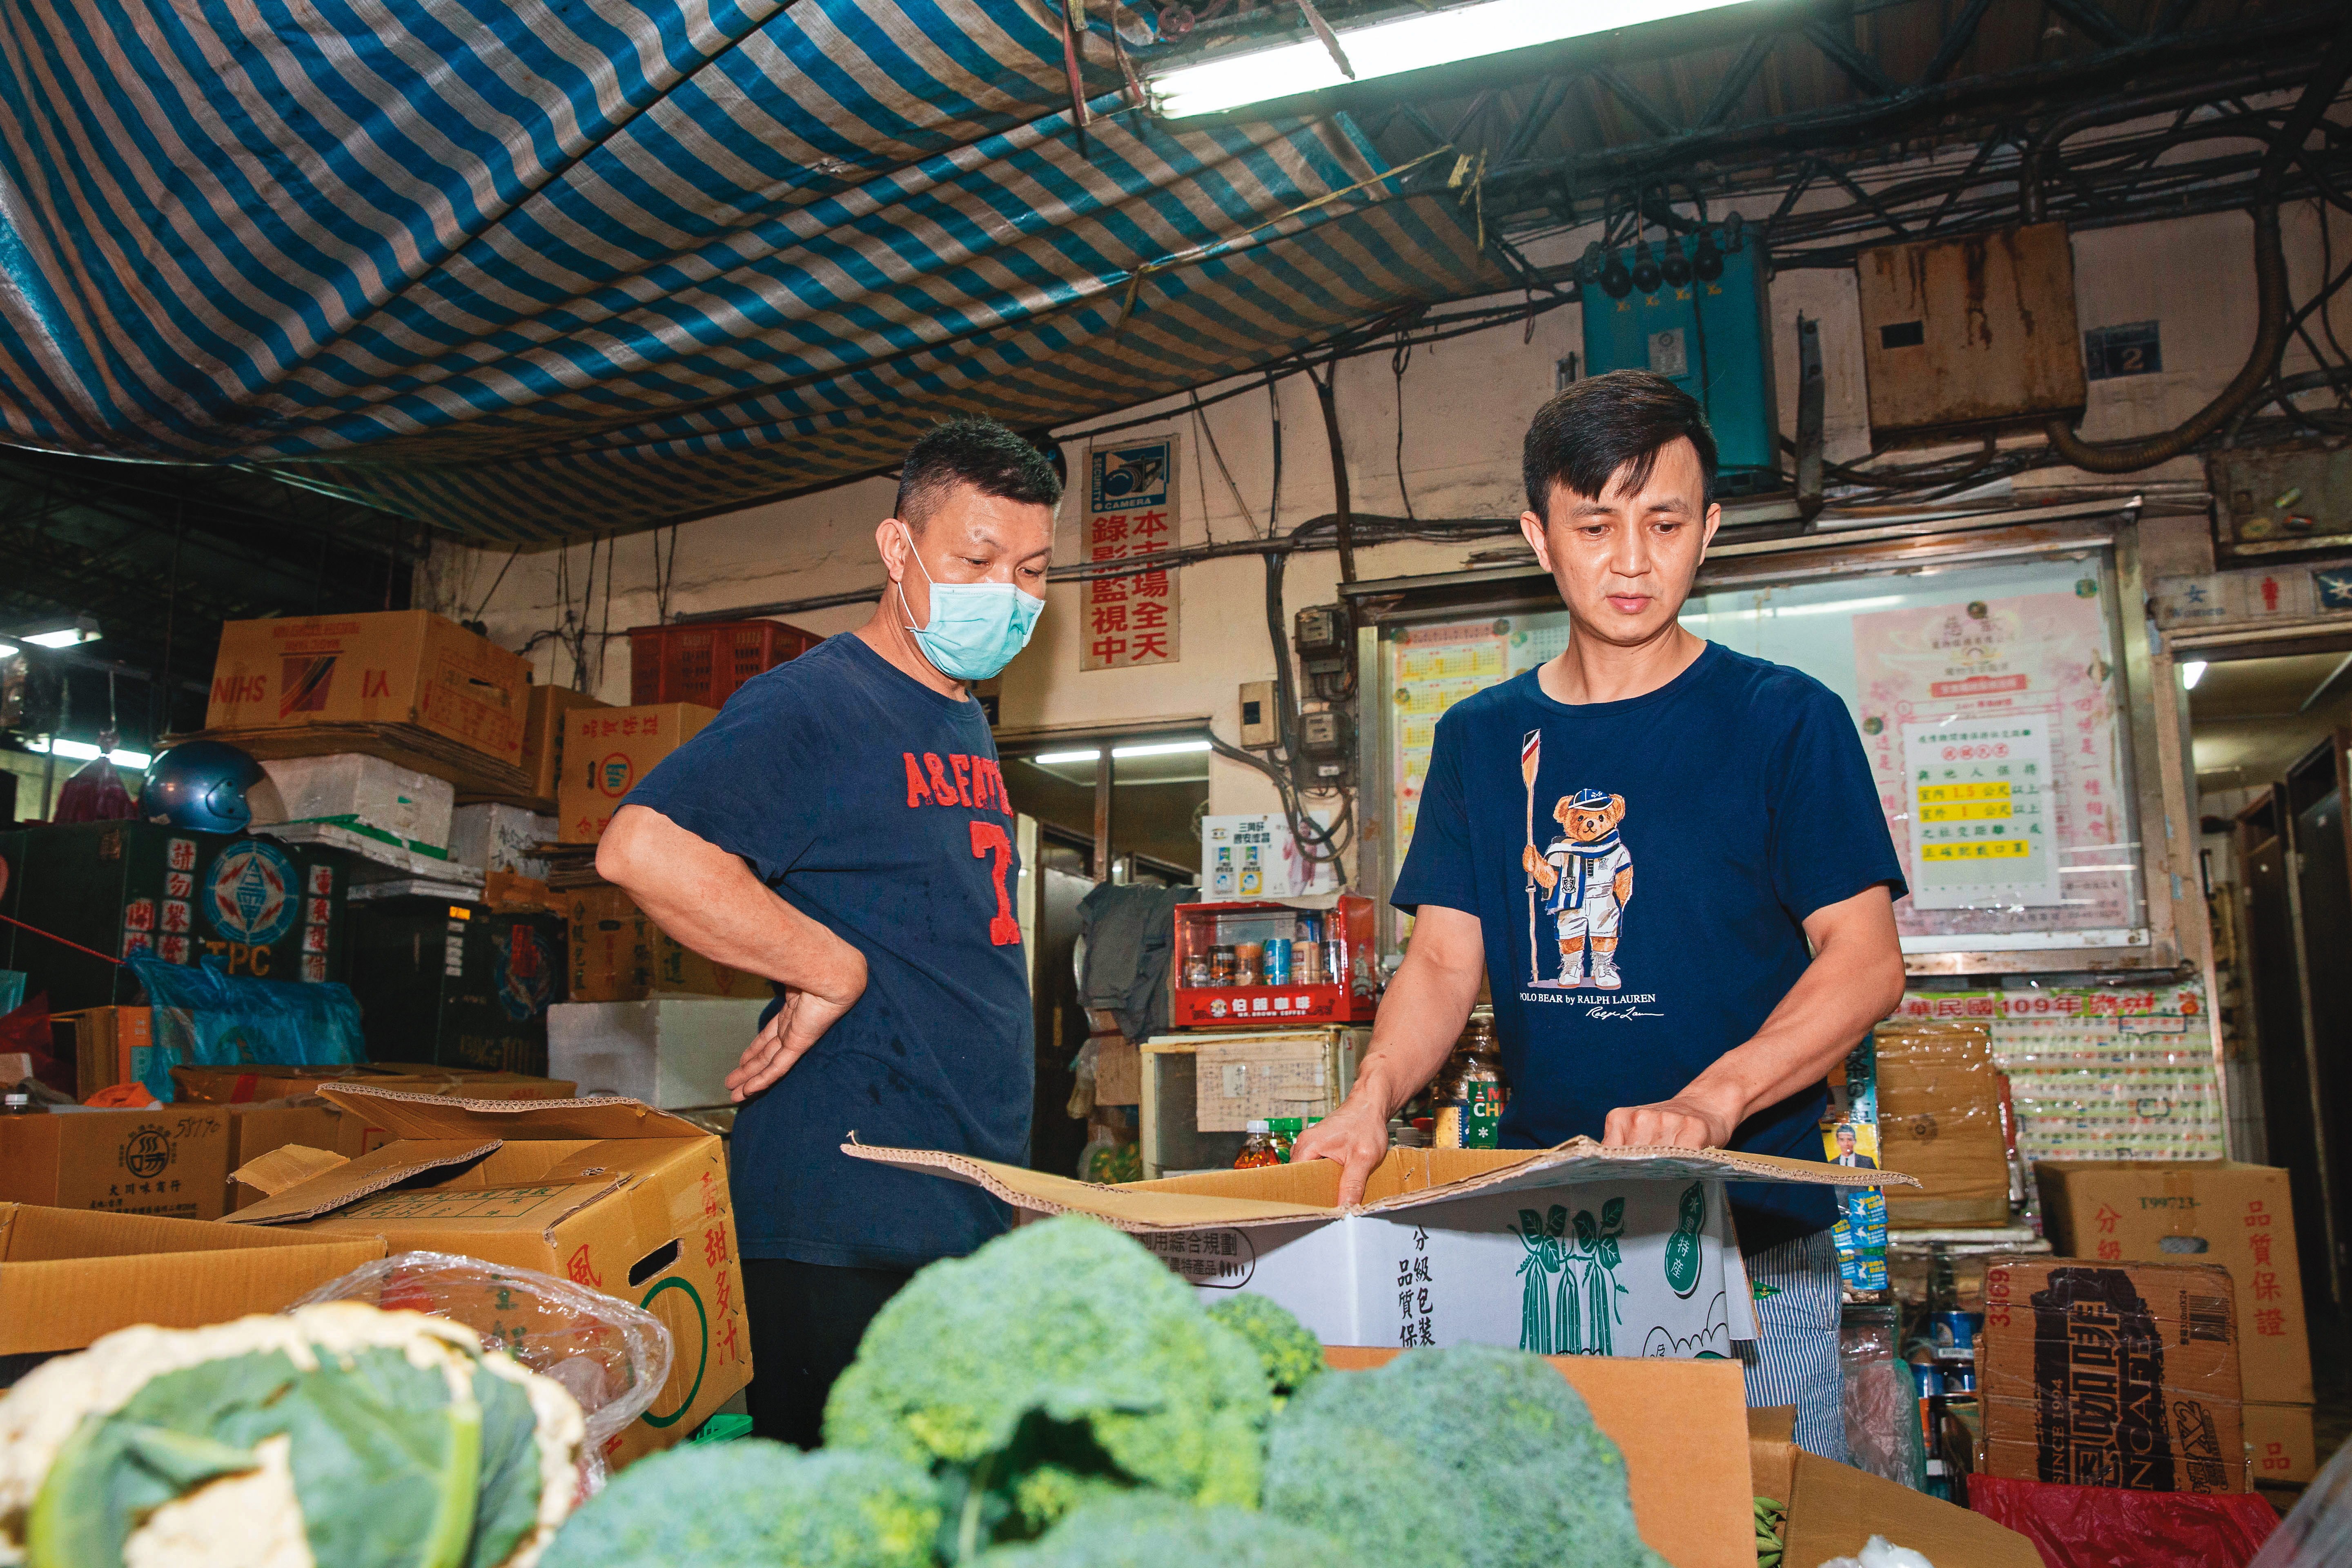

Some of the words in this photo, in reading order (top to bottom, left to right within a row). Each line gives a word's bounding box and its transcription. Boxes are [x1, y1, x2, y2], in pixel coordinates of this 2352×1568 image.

[2122, 348, 2144, 370] 2
[1094, 457, 1102, 502] SECURITY
[1105, 497, 1152, 510] CAMERA
[1091, 514, 1128, 664] 錄影監視中
[1132, 511, 1169, 661] 本市場全天
[213, 675, 267, 704] SHIN
[361, 670, 390, 698] YI
[161, 840, 196, 964] 請勿攀登
[970, 821, 1020, 946] 7
[206, 941, 271, 977] TPC
[1231, 996, 1312, 1013] 伯朗咖啡
[1520, 993, 1537, 1002] POLO
[1538, 993, 1563, 1003] BEAR
[1565, 995, 1575, 1005] by
[1577, 995, 1610, 1004] RALPH
[1613, 994, 1656, 1004] LAUREN
[1895, 993, 2082, 1017] 華民國109年
[2095, 1203, 2122, 1260] 分級
[1413, 1225, 1436, 1346] 分級包裝
[2244, 1200, 2286, 1337] 品質保證
[1397, 1259, 1418, 1348] 品質保
[1989, 1269, 2011, 1327] 3369
[2052, 1378, 2065, 1420] 1994
[2052, 1425, 2065, 1485] SINCE
[2262, 1442, 2290, 1470] 品
